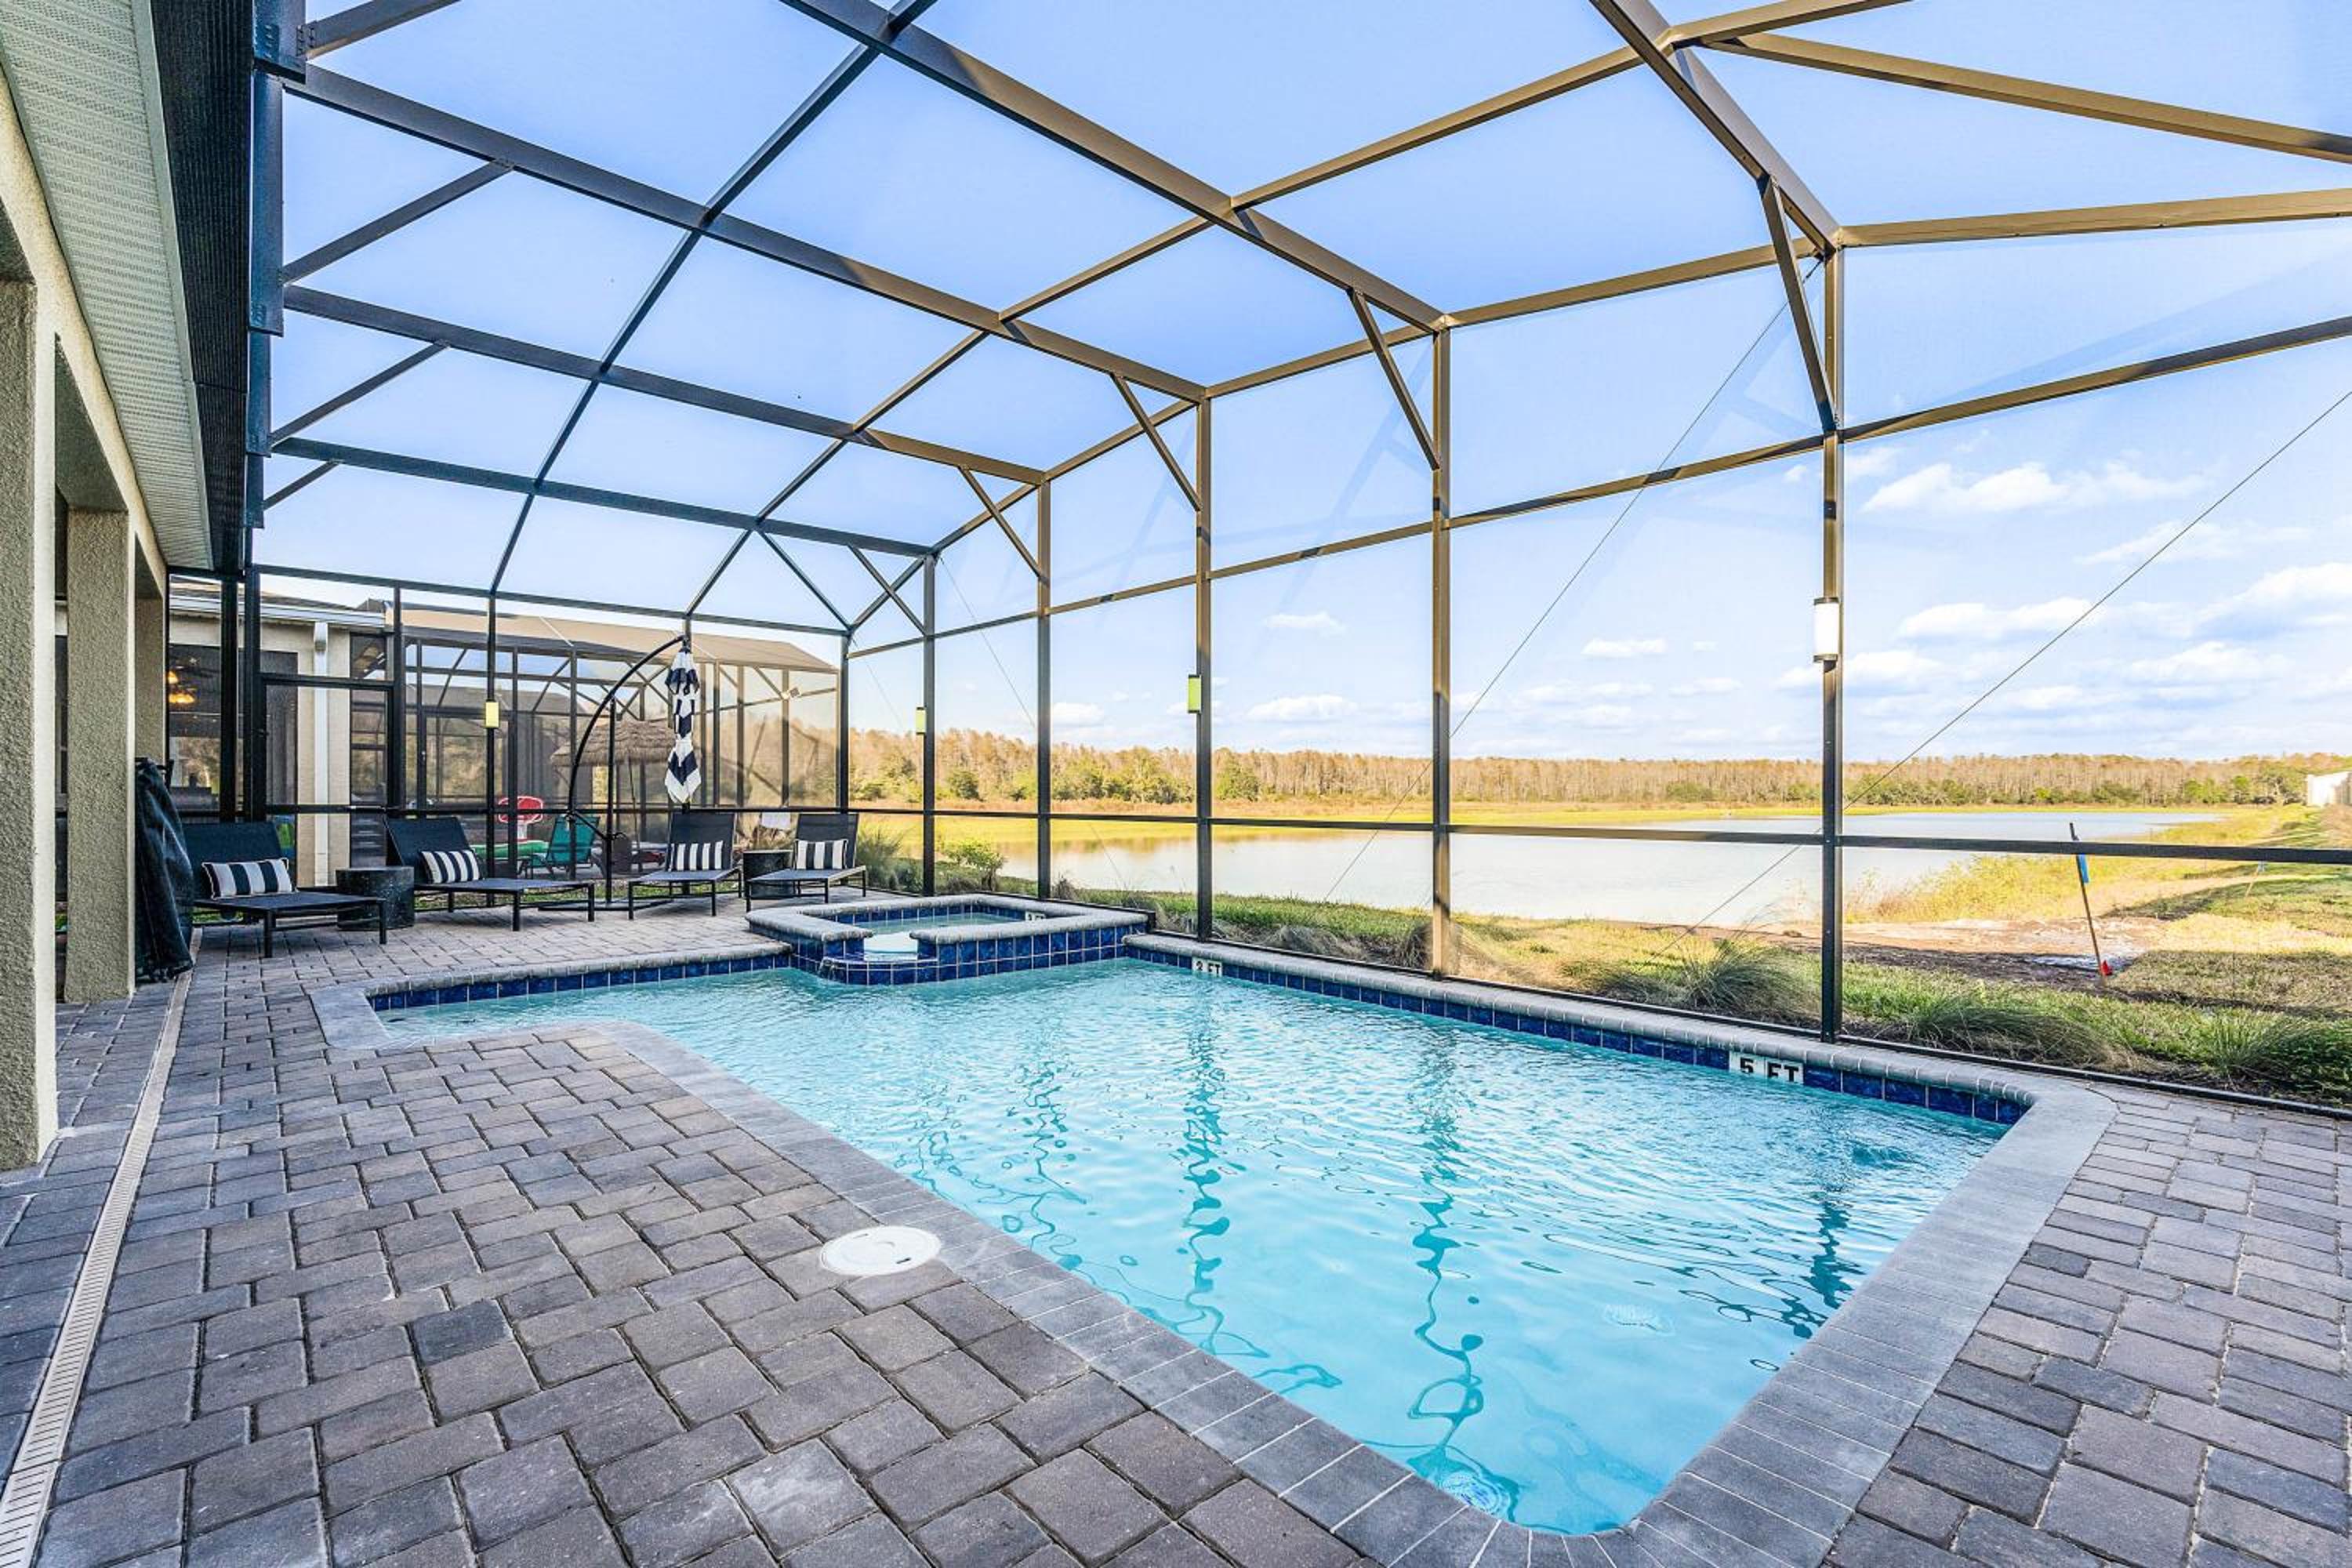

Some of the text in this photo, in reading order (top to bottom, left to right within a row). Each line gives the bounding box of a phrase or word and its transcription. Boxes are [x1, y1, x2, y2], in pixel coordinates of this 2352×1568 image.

[1208, 963, 1220, 975] FT
[1740, 1057, 1799, 1083] 5 FT
